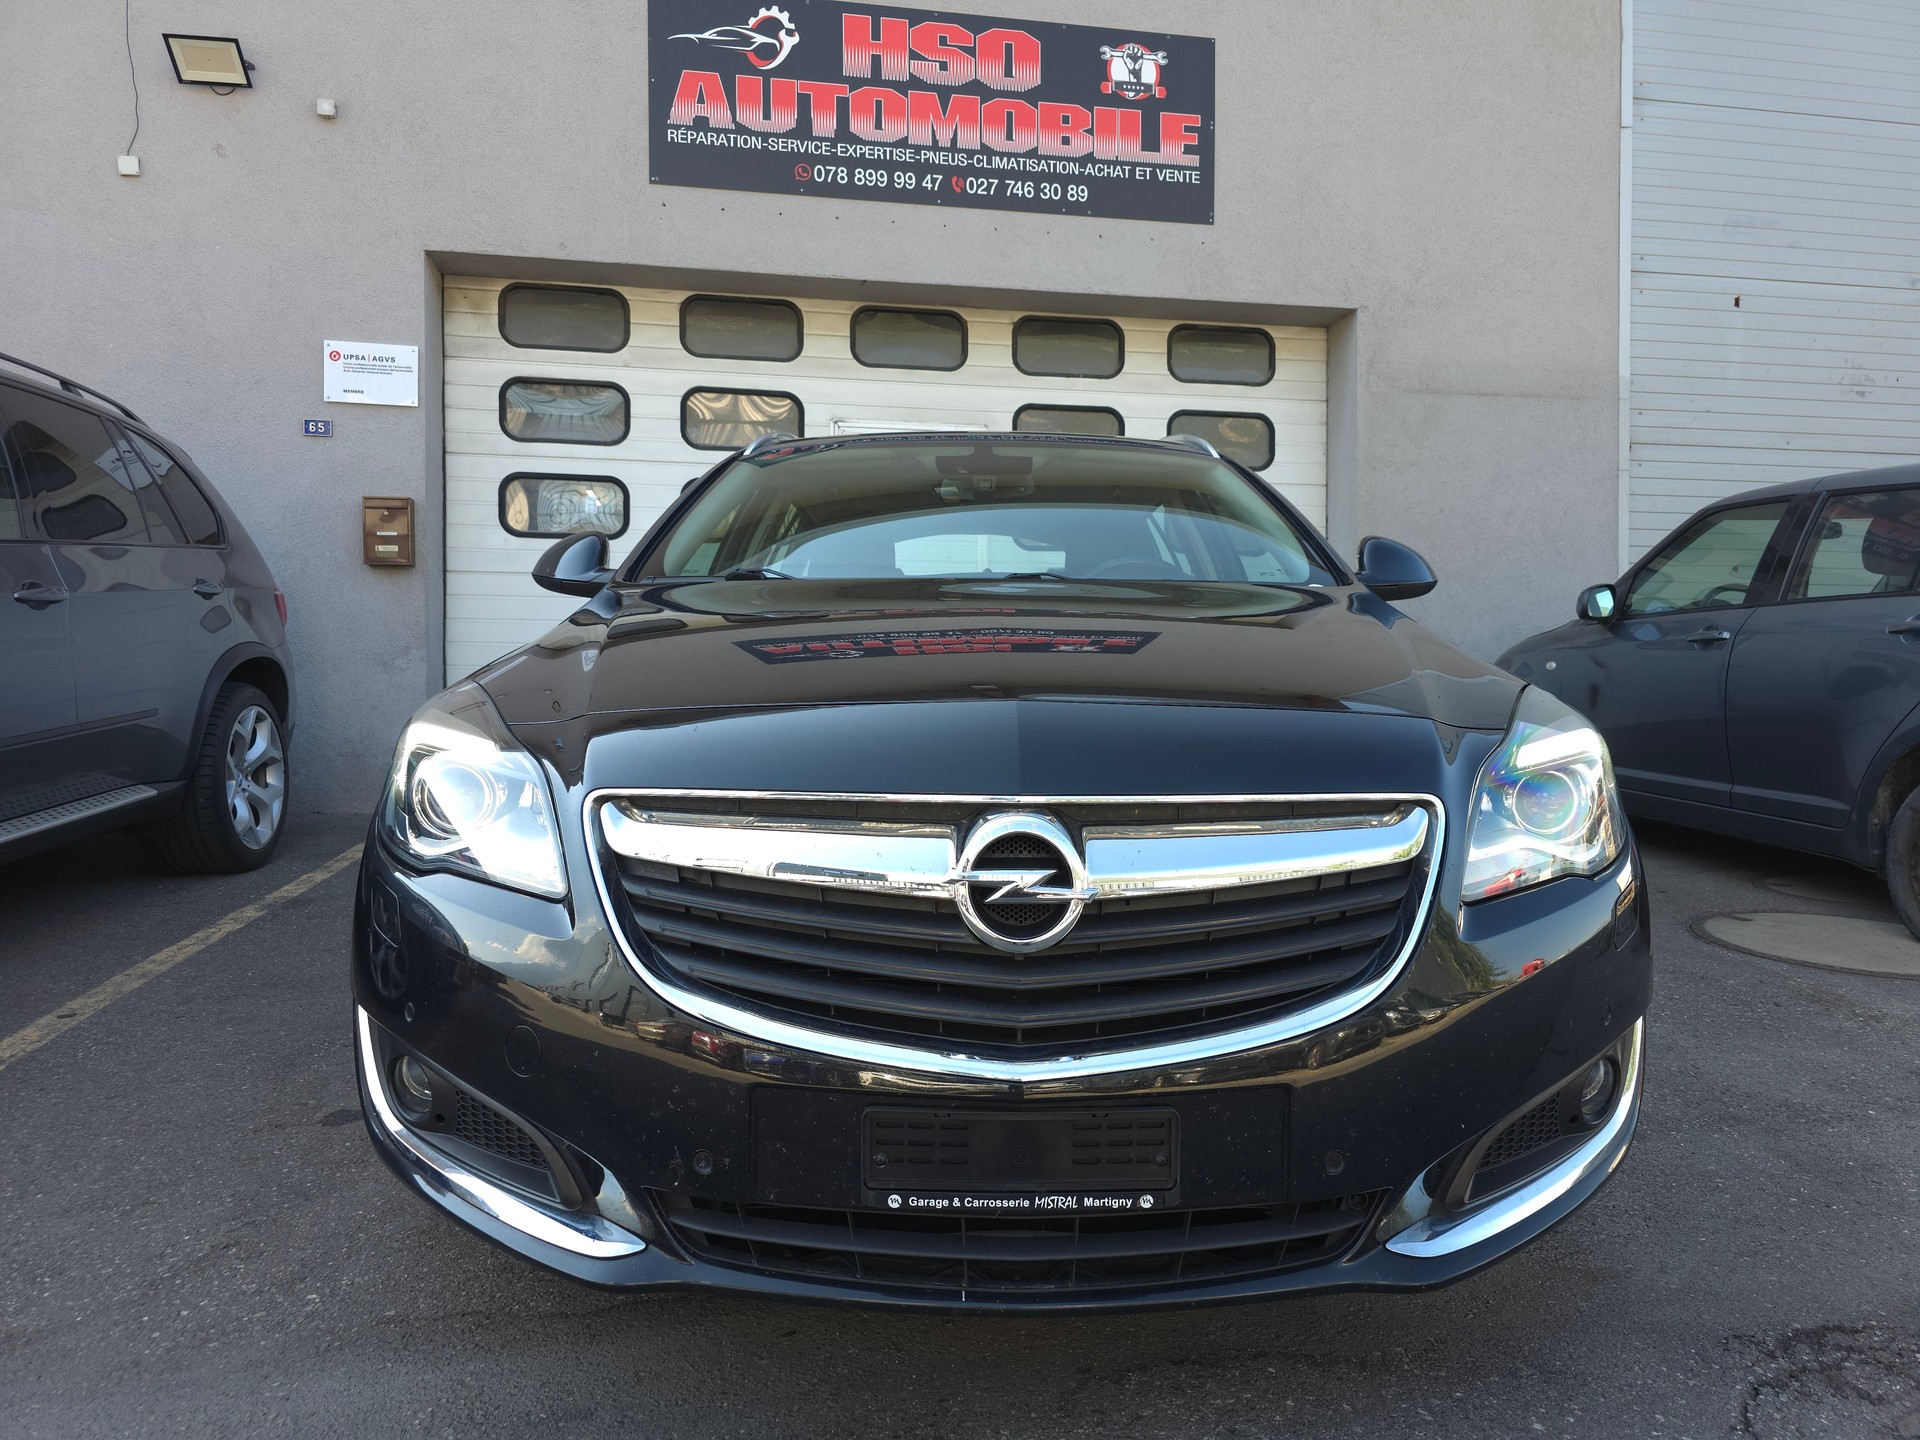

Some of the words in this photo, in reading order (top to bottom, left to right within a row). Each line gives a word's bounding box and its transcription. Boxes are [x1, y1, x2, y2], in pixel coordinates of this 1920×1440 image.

[842, 13, 1042, 92] HSO
[667, 69, 1201, 168] AUTOMOBILE
[813, 165, 848, 184] 078
[854, 168, 888, 187] 899
[893, 171, 916, 189] 99
[922, 173, 943, 192] 47
[965, 177, 999, 195] 027
[1005, 180, 1035, 198] 746
[1040, 183, 1062, 200] 30
[1067, 184, 1089, 202] 89
[1135, 167, 1153, 181] ET
[1156, 168, 1201, 184] VENTE
[343, 353, 366, 362] UPSA
[371, 355, 396, 363] AGVS
[309, 421, 325, 433] 65
[908, 1196, 949, 1209] Garage
[952, 1197, 961, 1207] &
[964, 1197, 1030, 1208] Carrosserie
[1034, 1195, 1078, 1209] MISTRAL
[1083, 1197, 1133, 1209] Martigny
